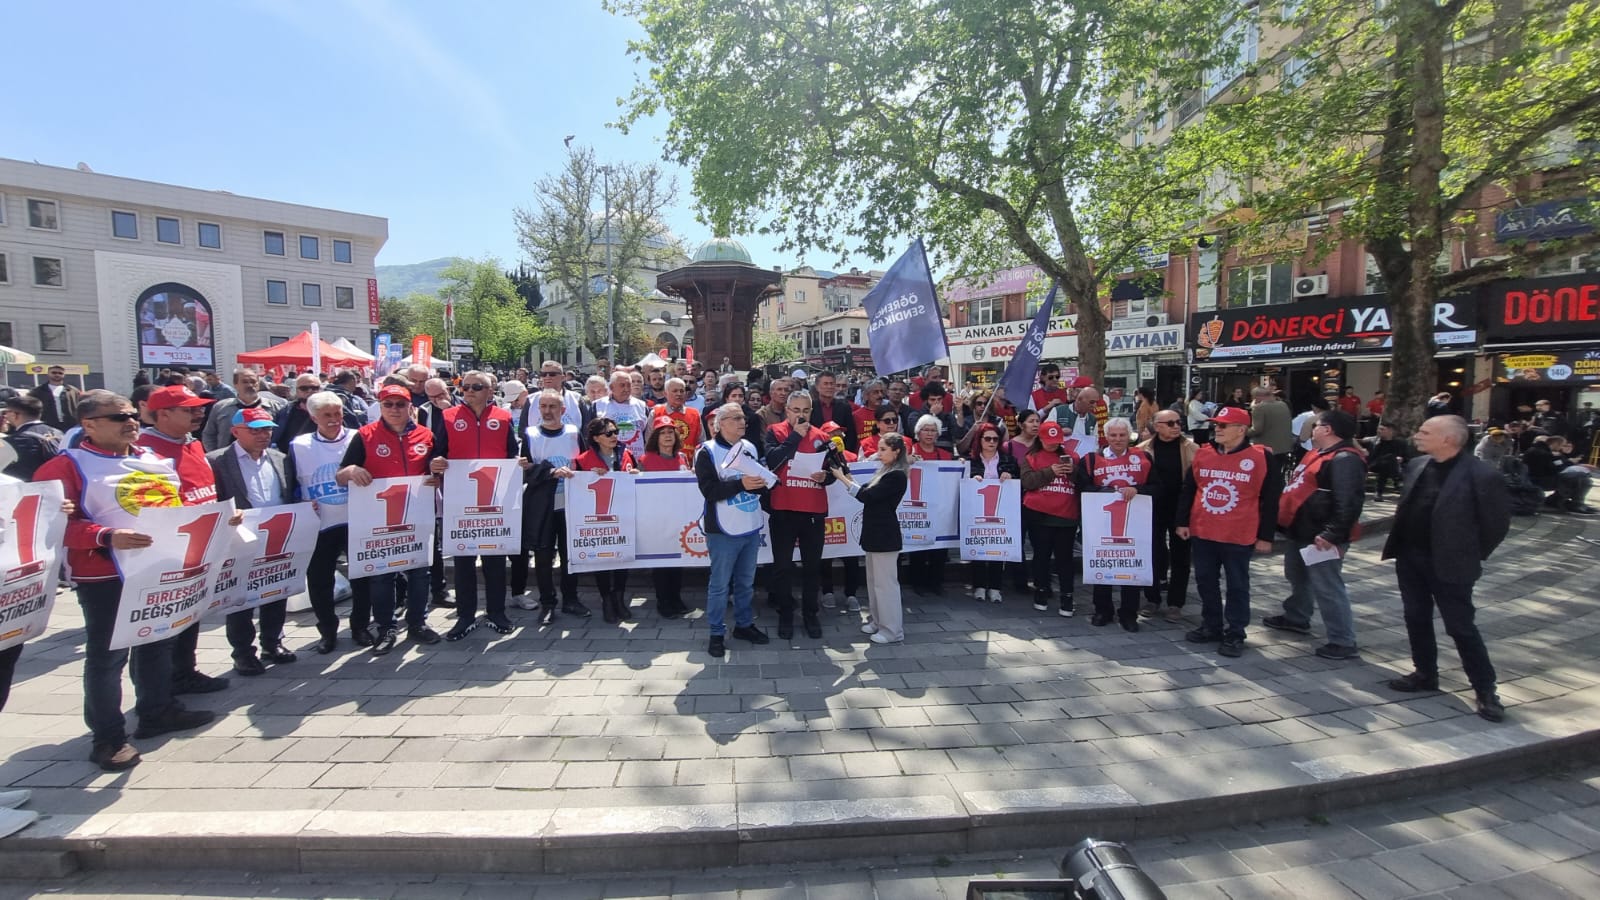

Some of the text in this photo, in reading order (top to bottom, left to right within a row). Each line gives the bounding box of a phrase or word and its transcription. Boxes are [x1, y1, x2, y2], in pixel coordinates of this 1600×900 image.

[964, 325, 1013, 339] ANKARA
[1232, 302, 1469, 342] DÖNERCİ YAR
[1284, 343, 1323, 353] Lezzetin
[1324, 341, 1356, 351] Adresi
[467, 465, 500, 507] 1
[587, 477, 616, 515] 1
[1206, 489, 1231, 502] DİSK
[375, 483, 412, 526] 1
[976, 484, 1003, 517] 1
[12, 494, 42, 565] 1
[899, 520, 931, 530] EĞİŞTİRELİM
[1102, 499, 1131, 537] 1
[177, 511, 223, 570] 1
[257, 511, 296, 556] 1
[450, 527, 511, 540] DEĞİŞTİRELİM
[572, 535, 627, 549] DEĞİŞTİRELİM
[687, 533, 708, 544] DİS
[965, 536, 1013, 546] DEĞİŞTİRELİM
[357, 542, 423, 561] DEĞİŞTİRELİM
[1089, 558, 1143, 570] DEĞİŞTİRELİM
[130, 586, 209, 623] DEĞİŞTİRELİM
[146, 578, 207, 606] BİRLEŞELİM
